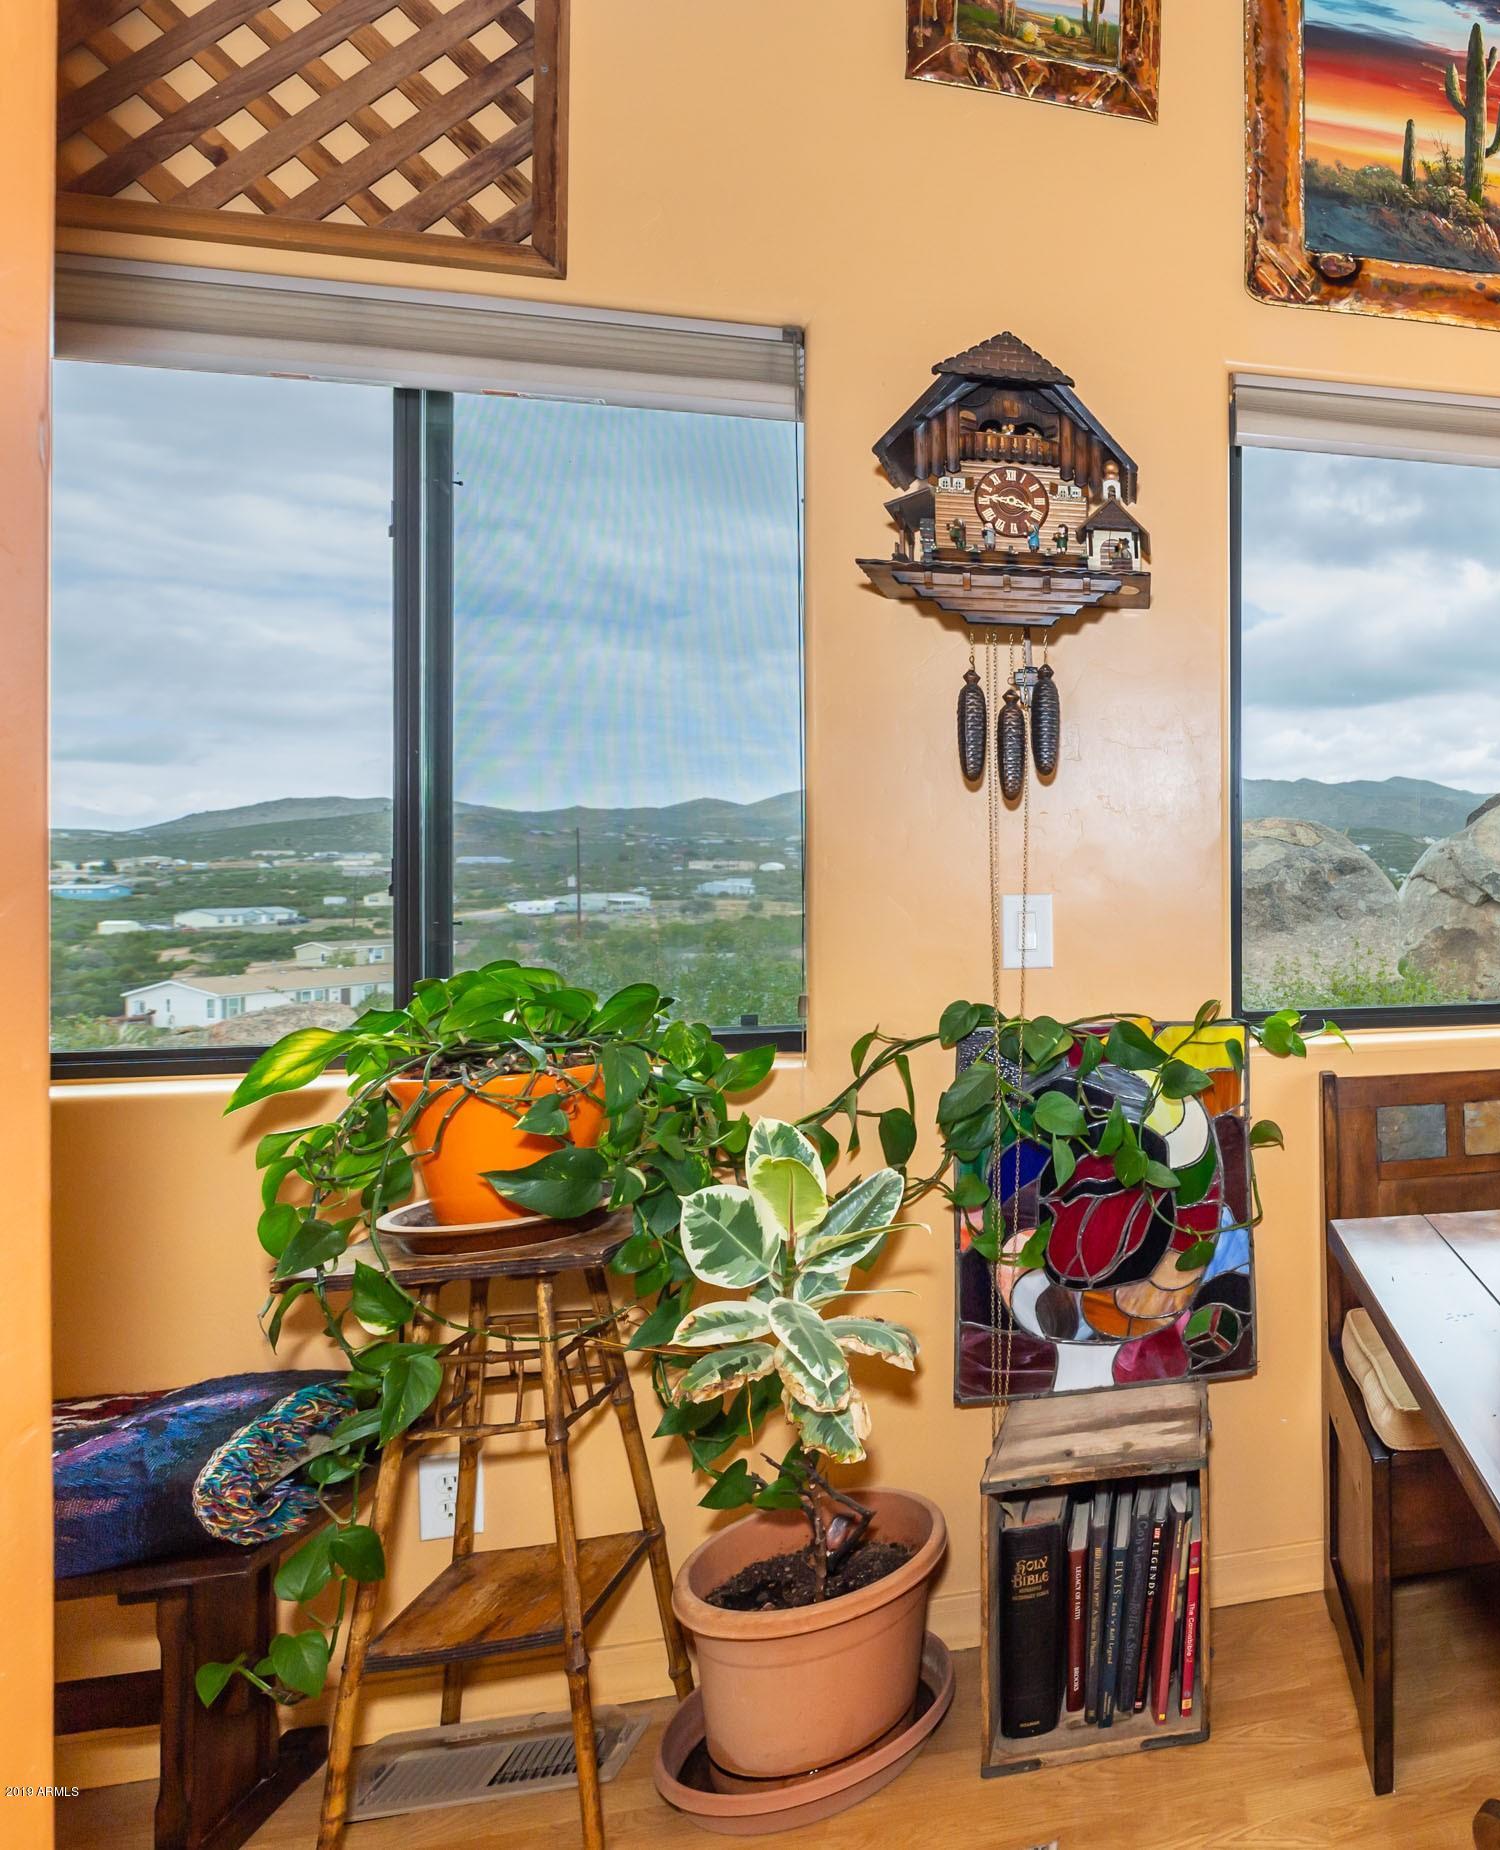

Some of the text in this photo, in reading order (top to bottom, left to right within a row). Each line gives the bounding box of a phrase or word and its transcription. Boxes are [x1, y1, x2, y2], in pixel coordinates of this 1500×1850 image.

[1015, 1555, 1048, 1576] HOLY
[1147, 1542, 1160, 1596] LEGENDS
[1011, 1571, 1049, 1588] BIBLE
[1188, 1603, 1196, 1616] The
